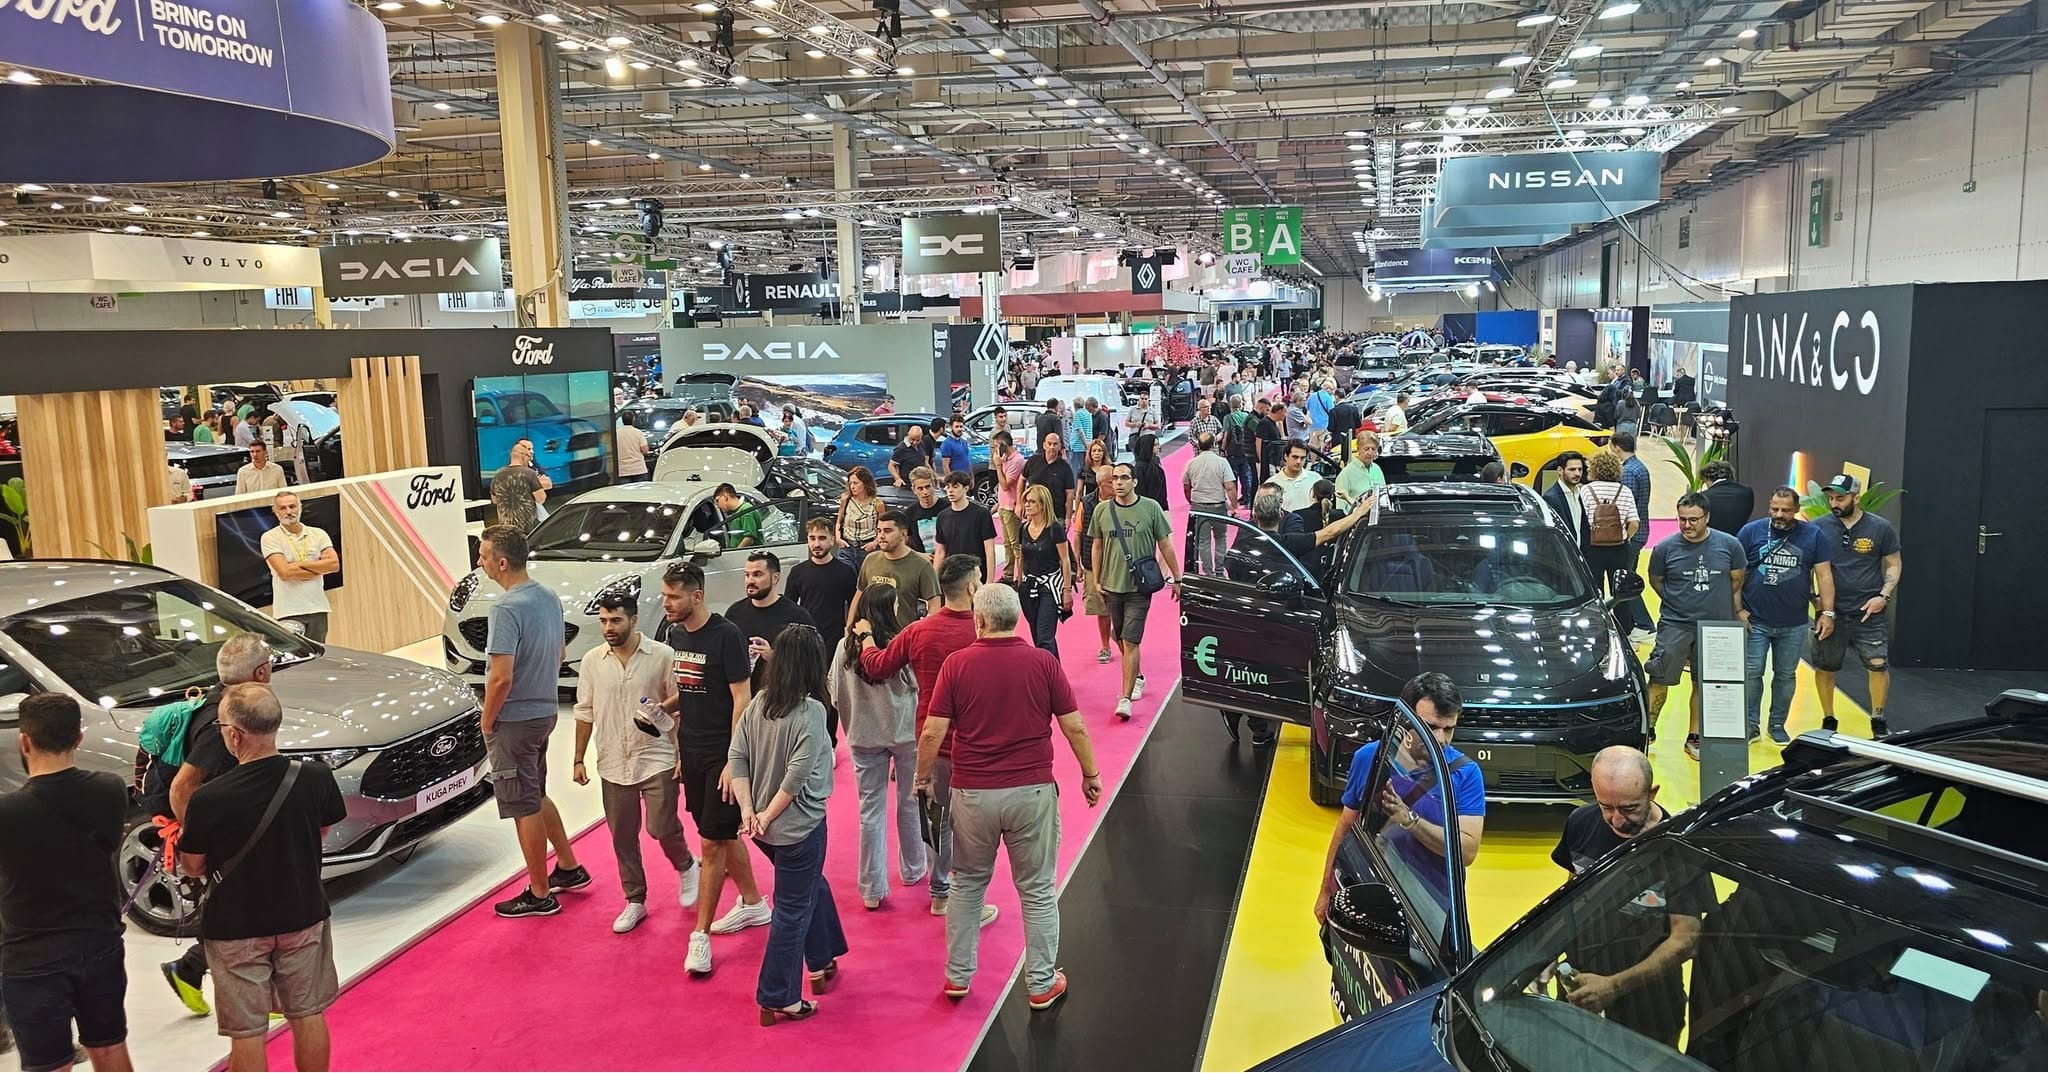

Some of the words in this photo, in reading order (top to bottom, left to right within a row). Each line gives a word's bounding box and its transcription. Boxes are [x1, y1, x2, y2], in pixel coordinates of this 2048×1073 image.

[0, 0, 122, 35] ord
[152, 0, 214, 32] BRING
[216, 14, 248, 40] ON
[152, 24, 274, 68] TOMORROW
[1488, 168, 1624, 189] NISSAN
[1230, 223, 1253, 251] B
[1267, 223, 1297, 256] A
[182, 255, 263, 269] VOLVO
[339, 256, 480, 281] DACIA
[1231, 266, 1254, 274] CAFE
[1454, 257, 1485, 265] KGM
[511, 334, 554, 366] Ford
[702, 341, 841, 361] DACIA
[406, 472, 457, 510] Ford
[1193, 635, 1219, 676] €
[1477, 749, 1492, 761] 01
[425, 786, 448, 803] KUGA
[448, 775, 468, 793] PHEV
